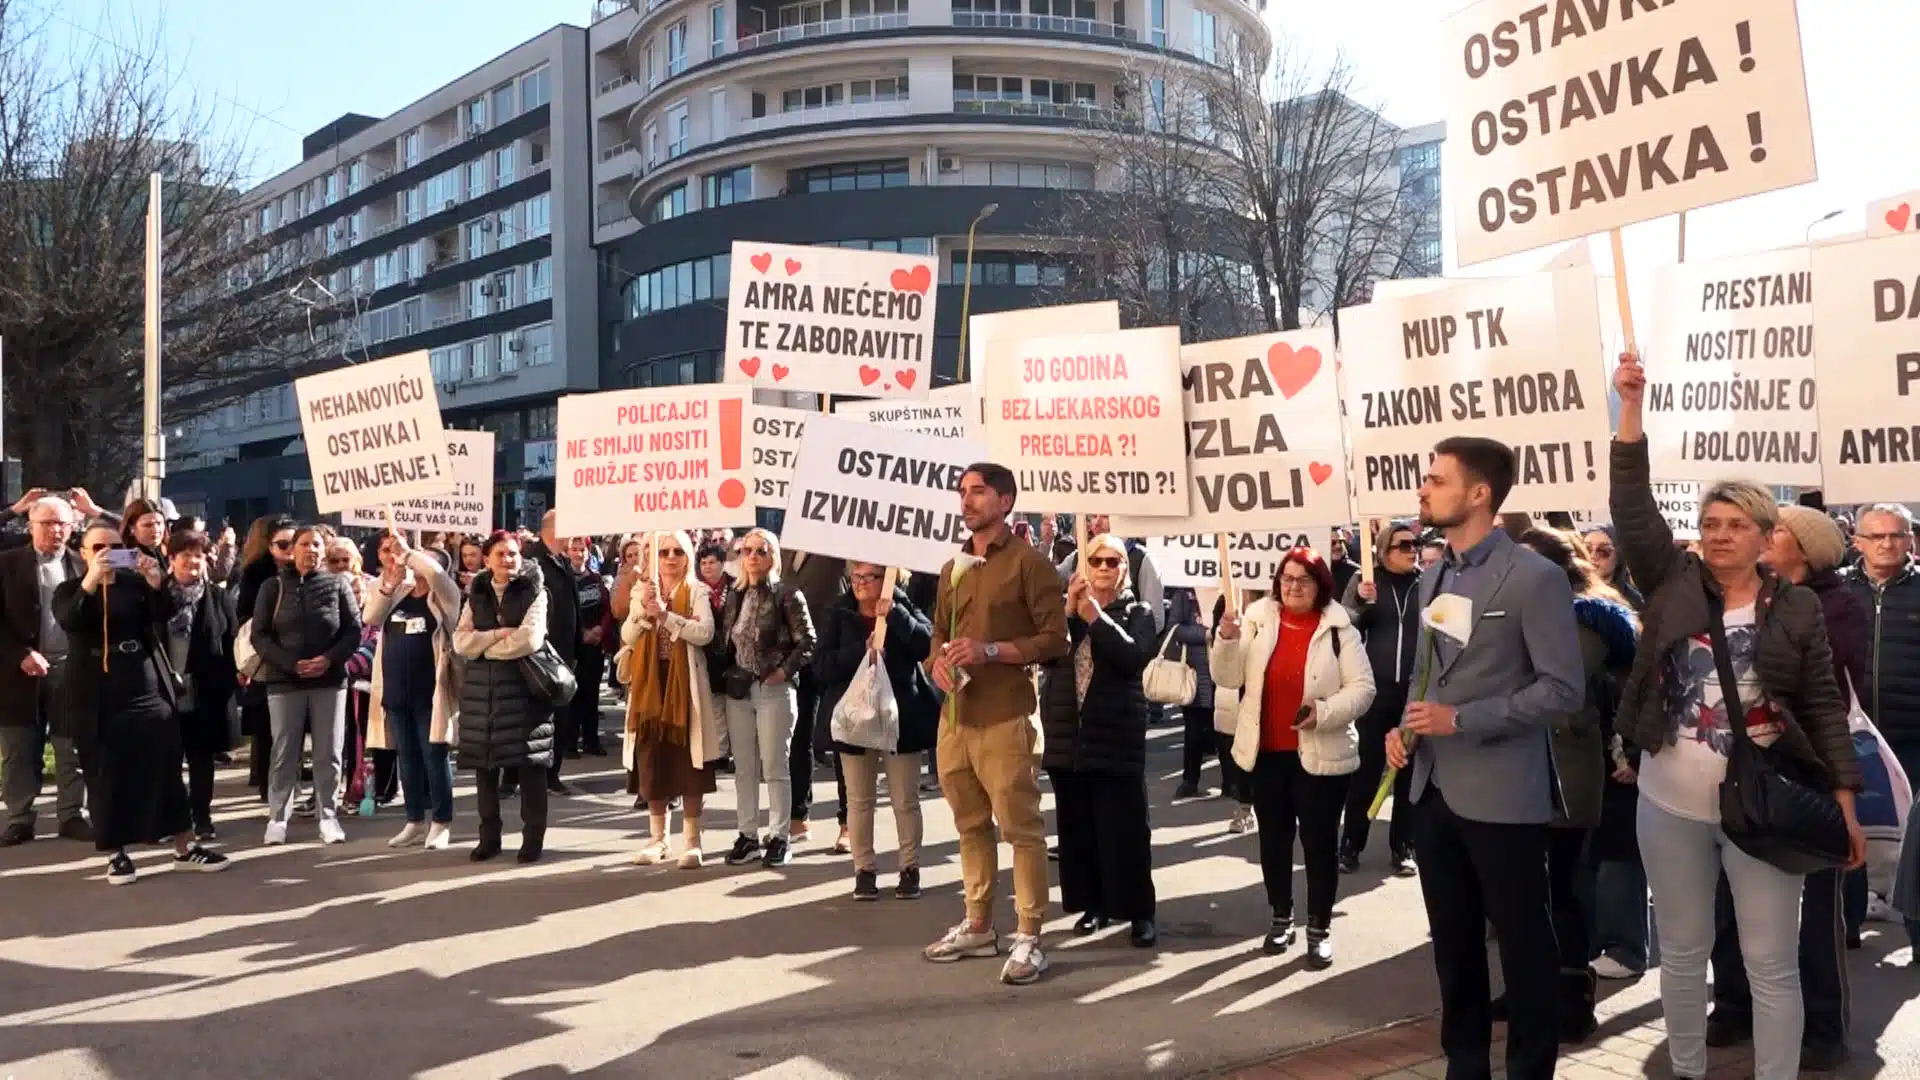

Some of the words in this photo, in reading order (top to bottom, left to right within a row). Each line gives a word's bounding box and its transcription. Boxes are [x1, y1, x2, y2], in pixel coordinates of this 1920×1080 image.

[1464, 0, 1674, 79] OSTAVK
[1471, 36, 1718, 156] OSTAVKA
[1736, 20, 1756, 73] !
[1478, 124, 1729, 232] OSTAVKA
[1746, 110, 1767, 163] !
[744, 281, 814, 312] AMRA
[823, 281, 922, 322] NEĆEMO
[739, 321, 769, 349] TE
[776, 323, 923, 361] ZABORAVITI
[1402, 315, 1457, 359] MUP
[1466, 306, 1508, 350] TK
[1686, 328, 1756, 362] NOSITI
[1763, 325, 1813, 359] ORU
[1023, 358, 1045, 383] 30
[1050, 353, 1129, 383] GODINA
[310, 374, 424, 423] MEHANOVIĆU
[1002, 398, 1031, 420] BEZ
[1035, 395, 1161, 421] LJEKARSKOG
[1361, 385, 1443, 428] ZAKON
[1449, 380, 1486, 421] SE
[1493, 369, 1585, 417] MORA
[1649, 383, 1675, 412] NA
[1681, 373, 1792, 411] GODIŠNJE
[1799, 377, 1816, 410] O
[617, 400, 708, 427] POLICAJCI
[868, 405, 942, 423] SKUPŠTINA
[945, 407, 963, 419] TK
[327, 420, 411, 457] OSTAVKA
[412, 418, 421, 441] I
[566, 439, 588, 460] NE
[593, 433, 644, 457] SMIJU
[649, 429, 708, 452] NOSITI
[1020, 434, 1113, 457] PREGLEDA
[1118, 433, 1137, 457] ?!
[1681, 430, 1687, 460] I
[1693, 431, 1818, 464] BOLOVANJ
[323, 455, 430, 495] IZVINJENJE
[431, 454, 441, 477] !
[573, 461, 638, 485] ORUŽJE
[643, 459, 709, 482] SVOJIM
[1583, 441, 1596, 481] !
[634, 486, 709, 512] KUĆAMA
[1020, 469, 1035, 492] LI
[1038, 469, 1073, 493] VAS
[1077, 471, 1100, 494] JE
[1105, 471, 1150, 494] STID
[1155, 471, 1176, 494] ?!
[1195, 468, 1304, 514] VOLI
[354, 508, 376, 521] NEK
[431, 500, 451, 511] IMA
[453, 502, 485, 513] PUNO
[801, 488, 970, 545] IZVINJENJE
